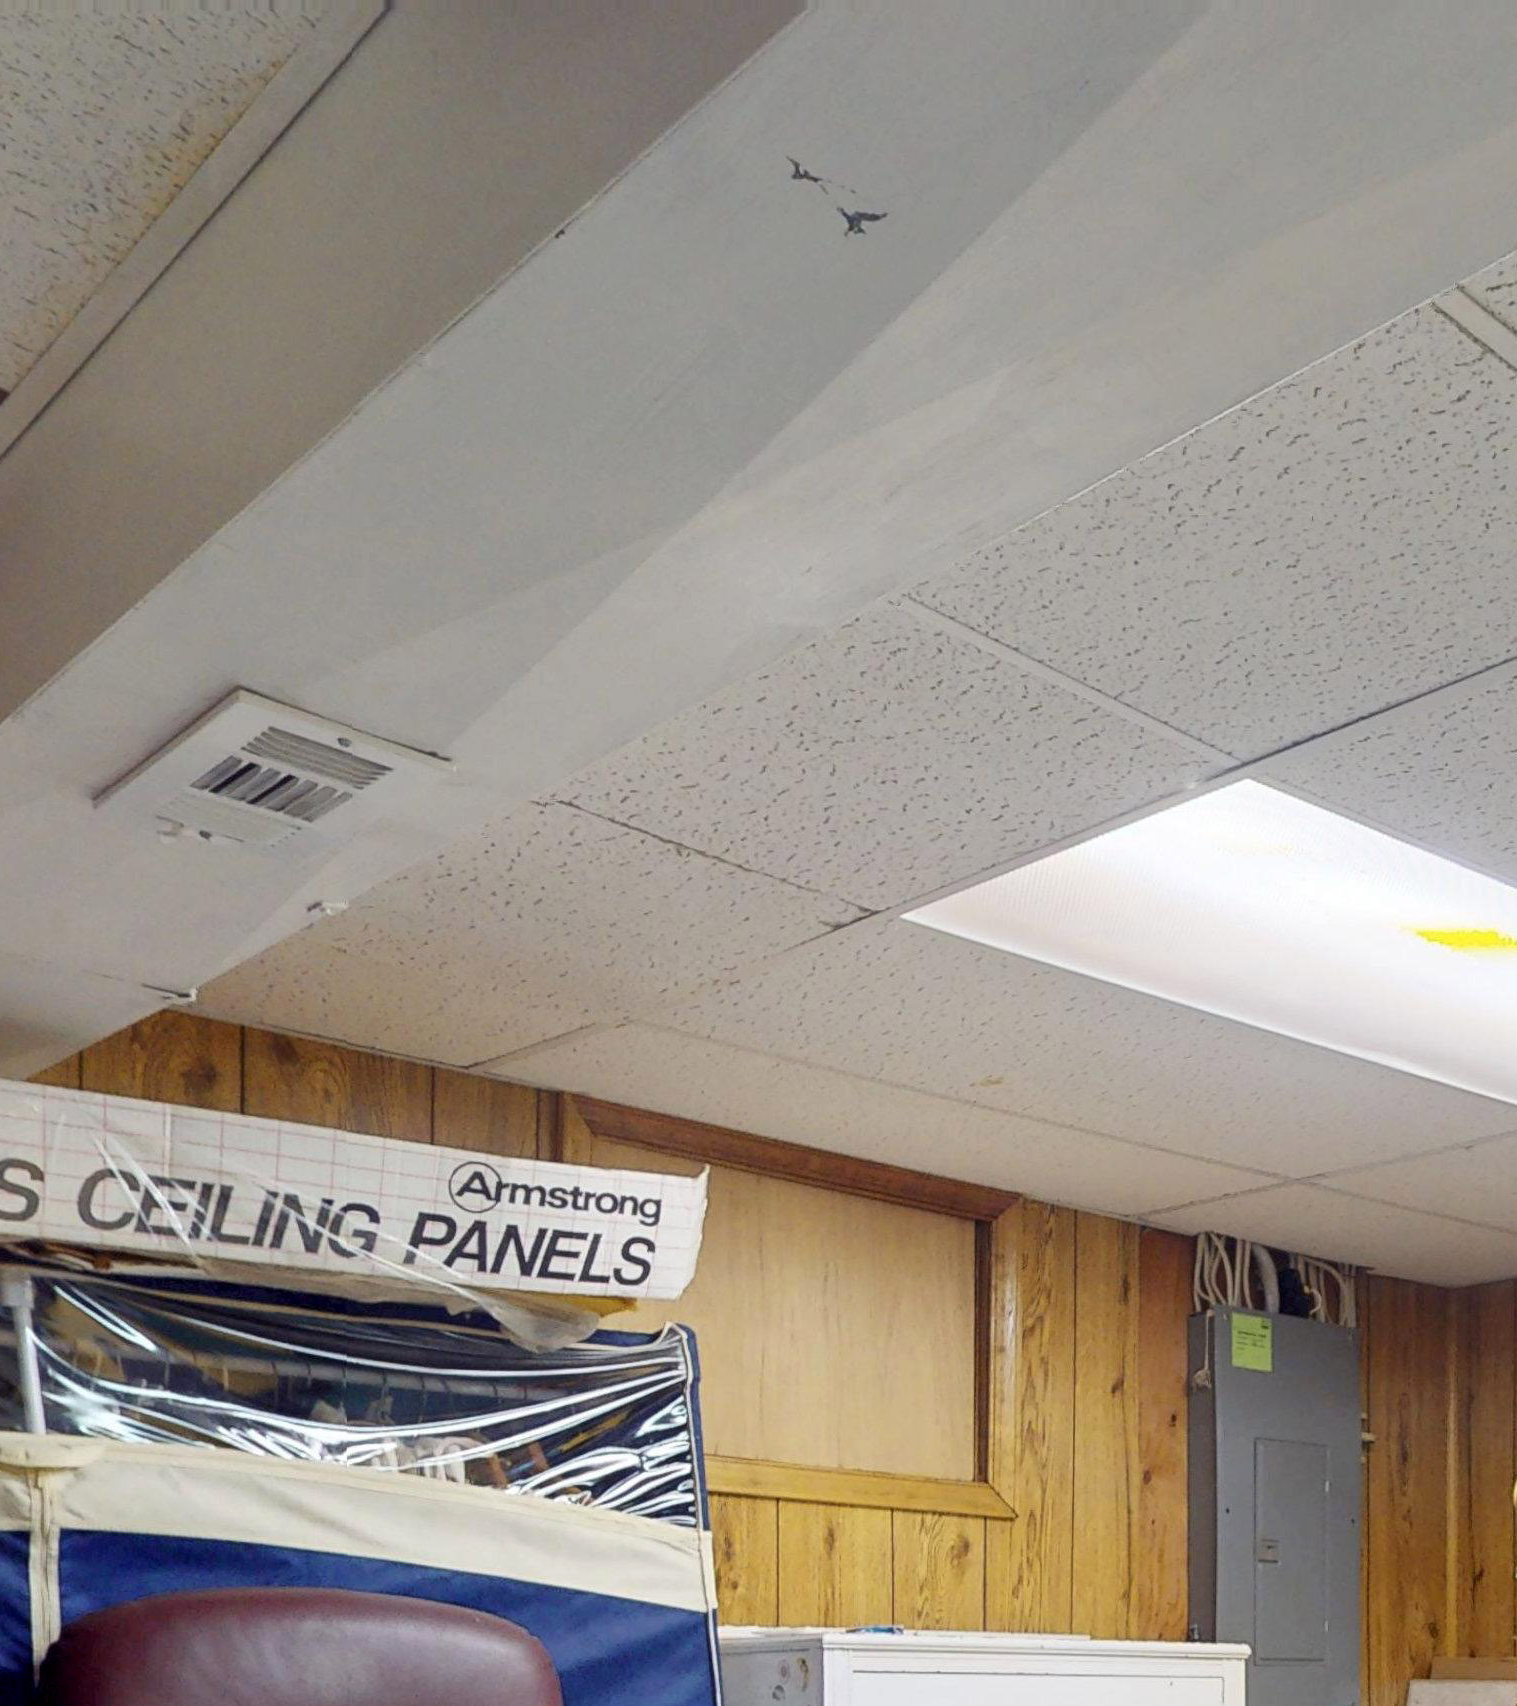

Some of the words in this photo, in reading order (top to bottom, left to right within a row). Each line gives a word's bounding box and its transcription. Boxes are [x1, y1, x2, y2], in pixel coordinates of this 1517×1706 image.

[76, 1166, 382, 1260] CEILING
[403, 1210, 657, 1288] PANELS
[451, 1163, 663, 1228] Armstrong
